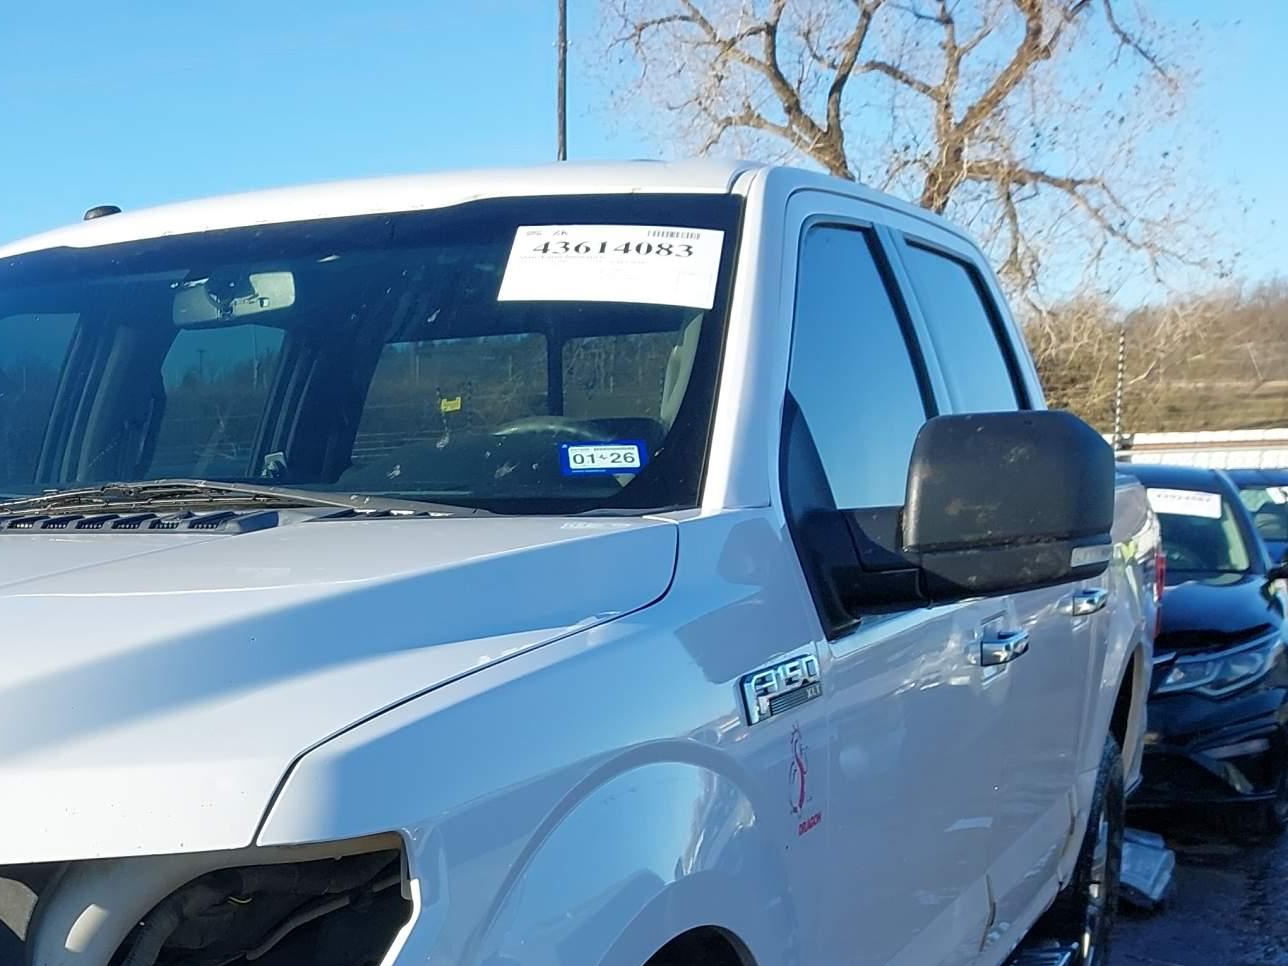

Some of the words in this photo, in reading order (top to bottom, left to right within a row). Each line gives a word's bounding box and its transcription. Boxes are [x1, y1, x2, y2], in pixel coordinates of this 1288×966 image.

[532, 240, 694, 258] 43614083
[573, 453, 595, 465] 01
[610, 451, 635, 464] 26
